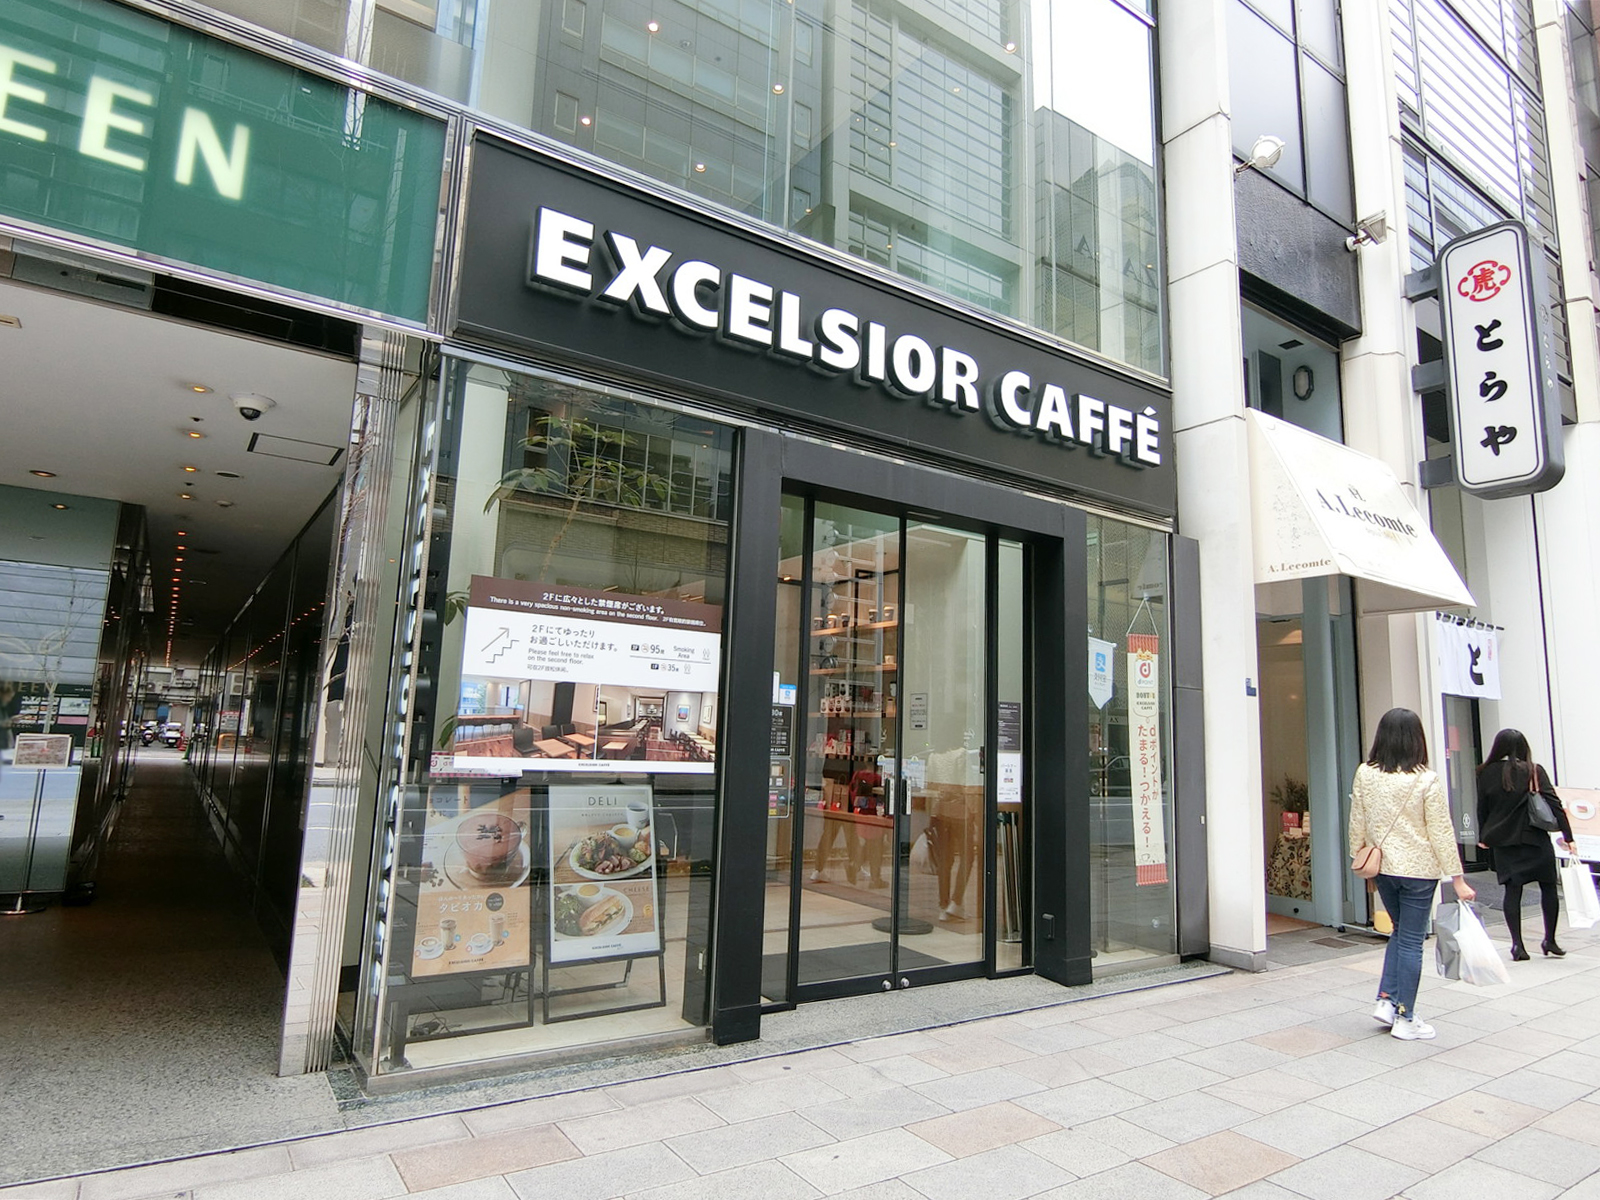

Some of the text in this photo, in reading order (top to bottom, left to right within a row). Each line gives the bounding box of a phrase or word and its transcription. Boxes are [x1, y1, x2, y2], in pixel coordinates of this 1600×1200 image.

[1472, 267, 1496, 294] 虎
[535, 205, 1162, 467] EXCELSIOR CAFFÉ
[1474, 319, 1517, 457] とらや
[489, 596, 507, 604] There
[520, 600, 533, 608] very
[560, 605, 595, 615] non-smoking
[617, 610, 625, 618] the
[626, 612, 645, 620] second
[532, 624, 595, 638] 2Fにてゆったり
[530, 636, 618, 652] お過ごしいただけます。
[673, 645, 695, 654] Smoking
[528, 648, 547, 656] Please
[547, 656, 567, 664] second
[569, 657, 584, 665] floor.
[588, 796, 618, 806] DELI
